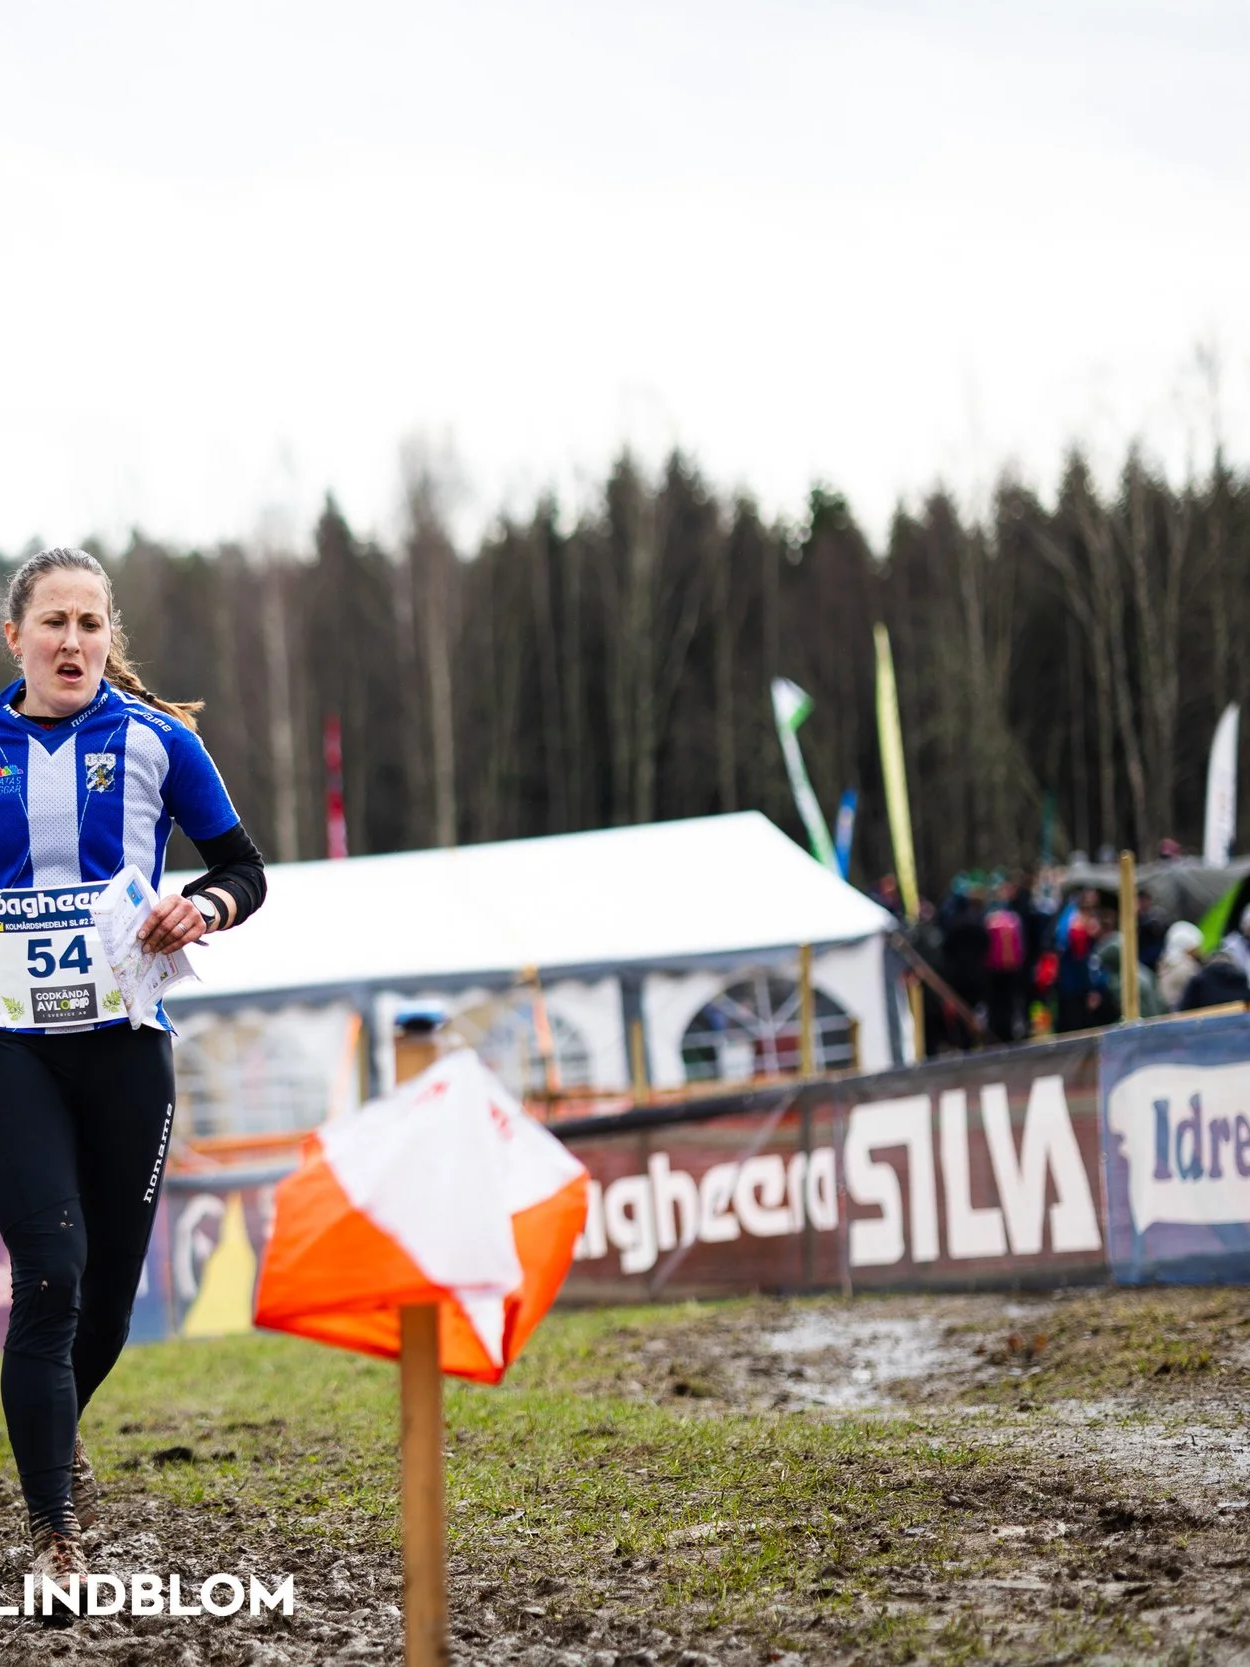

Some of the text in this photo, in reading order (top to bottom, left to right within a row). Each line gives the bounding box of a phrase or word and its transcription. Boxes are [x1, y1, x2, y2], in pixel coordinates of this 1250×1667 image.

[69, 919, 79, 927] SL
[79, 917, 89, 926] #2
[27, 935, 93, 979] 54
[35, 989, 90, 1001] GODKÄNDA
[36, 997, 90, 1012] AVLOPP
[143, 1102, 173, 1204] noname
[844, 1074, 1104, 1267] SILVA
[573, 1147, 840, 1275] gheera
